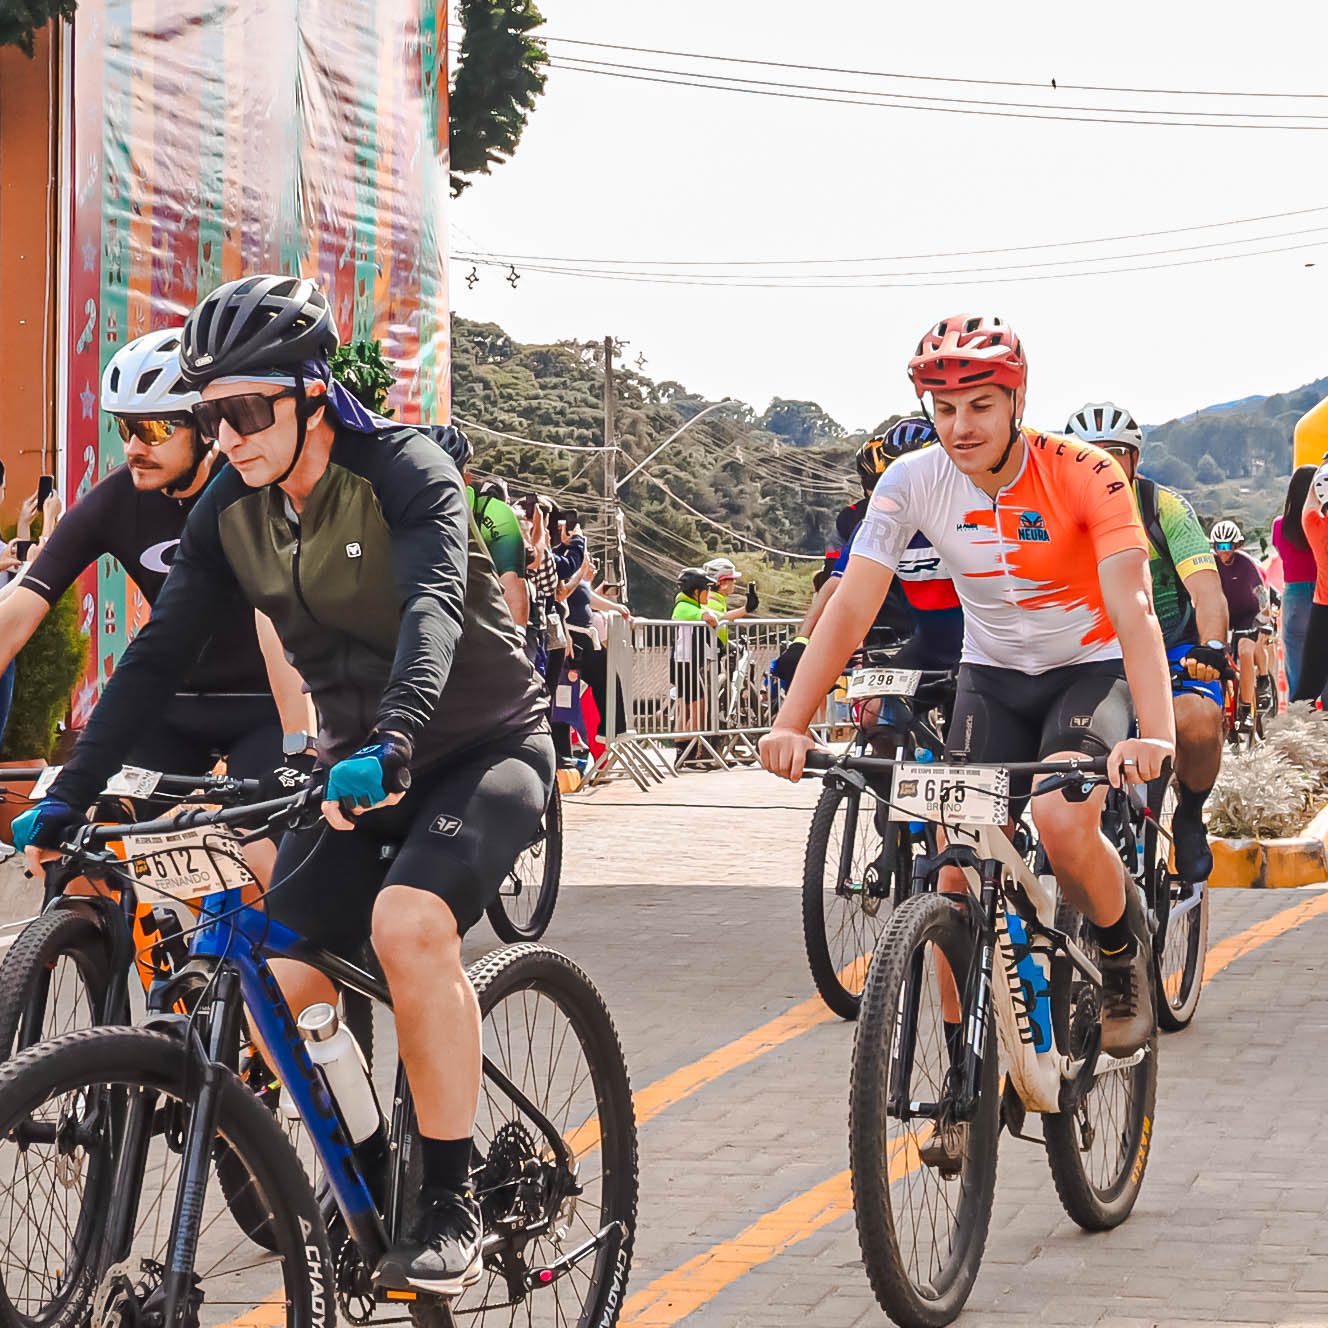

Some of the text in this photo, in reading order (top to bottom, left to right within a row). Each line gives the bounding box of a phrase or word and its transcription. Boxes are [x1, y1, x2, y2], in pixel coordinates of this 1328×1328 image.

[1033, 433, 1126, 495] NEURA
[1017, 527, 1051, 542] NEURA
[868, 674, 894, 687] 298
[273, 766, 311, 784] FOX
[924, 779, 966, 803] 655
[151, 849, 200, 879] 612
[155, 871, 211, 890] FERNANDO
